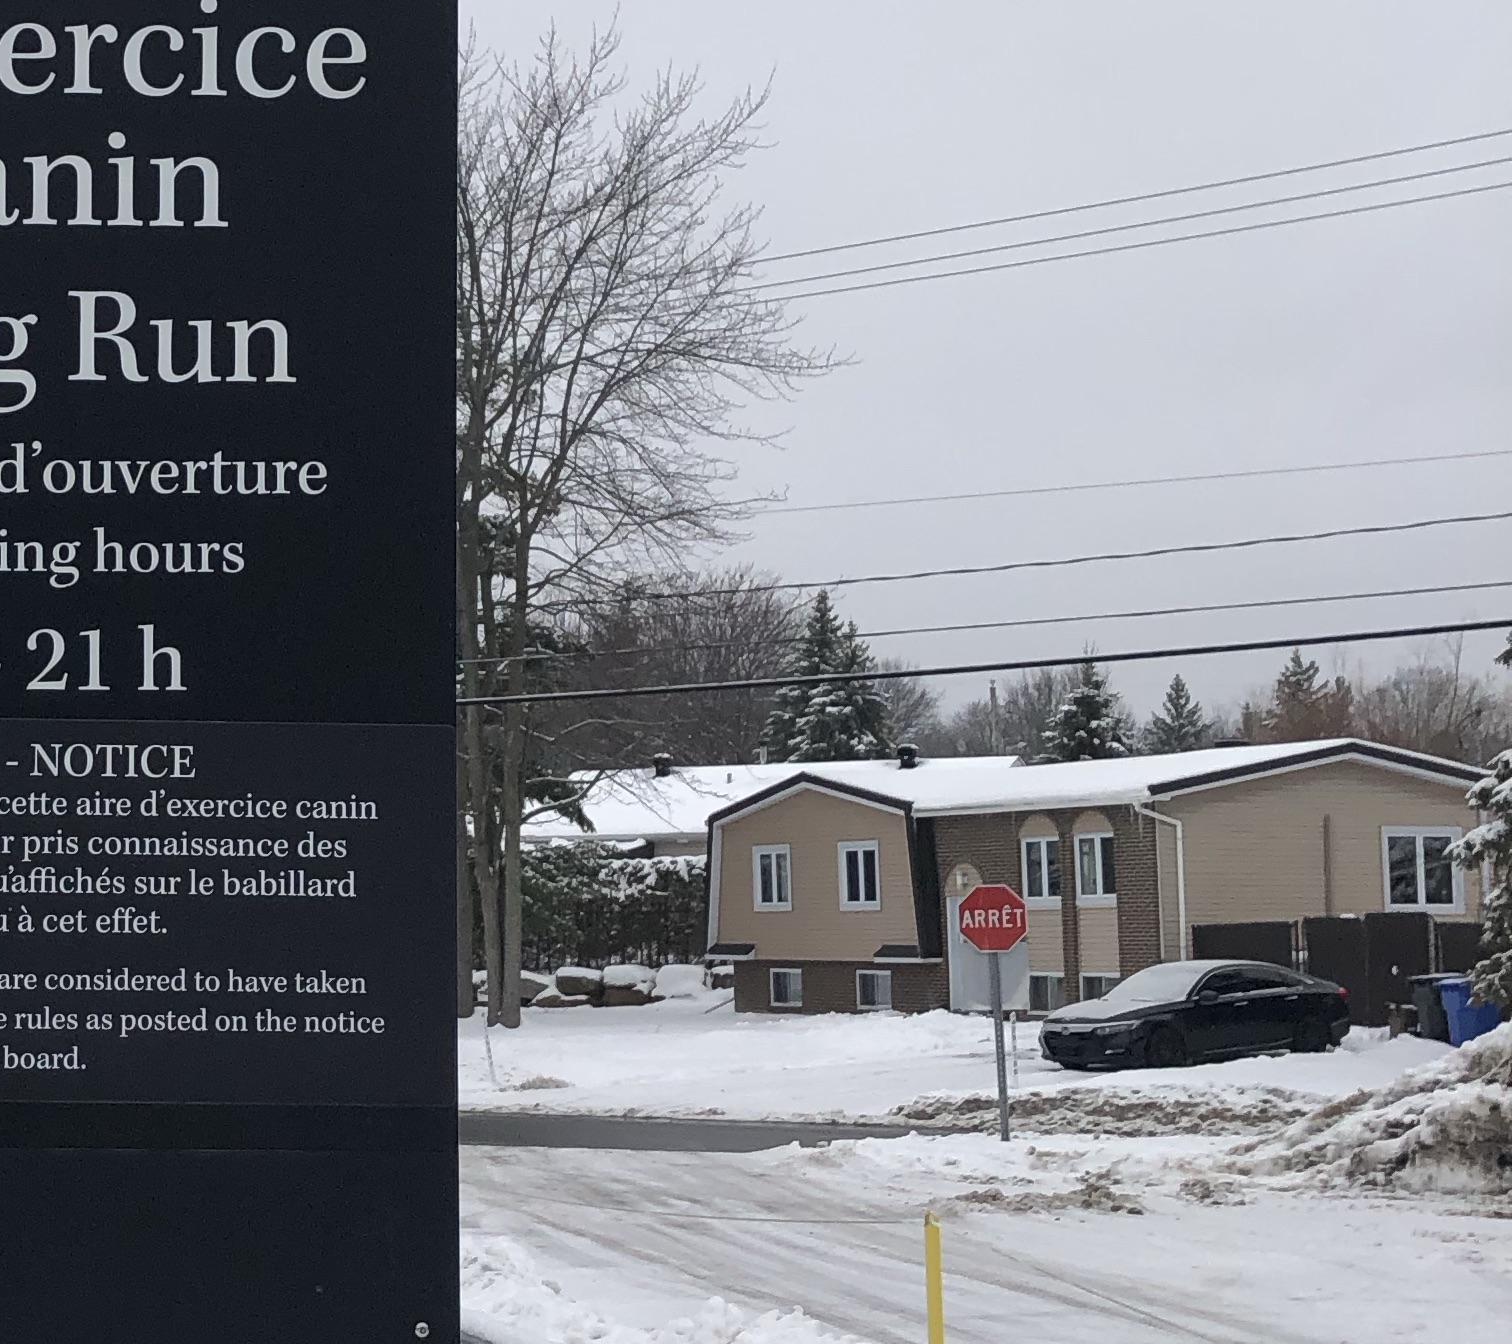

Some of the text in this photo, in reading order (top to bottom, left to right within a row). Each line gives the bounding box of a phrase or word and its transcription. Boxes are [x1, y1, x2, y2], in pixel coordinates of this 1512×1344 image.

[67, 291, 297, 384] Run
[92, 526, 245, 574] hours
[25, 628, 111, 691] 21
[137, 623, 188, 691] h
[29, 743, 196, 779] NOTICE
[76, 790, 132, 817] aire
[139, 788, 288, 819] d'exercice
[295, 794, 379, 820] canin
[21, 829, 79, 863] pris
[87, 830, 289, 858] connaissance
[297, 830, 347, 858] des
[134, 876, 182, 895] sur
[188, 868, 215, 896] le
[221, 868, 357, 898] babillard
[17, 904, 36, 933] à
[42, 909, 88, 934] cet
[95, 906, 168, 934] effet.
[961, 904, 1024, 929] ARRÊT
[44, 967, 188, 992] considered
[193, 971, 221, 992] to
[227, 968, 288, 993] have
[293, 969, 367, 994] taken
[13, 1005, 79, 1030] rules
[85, 1013, 113, 1031] as
[119, 1007, 209, 1038] posted
[214, 1015, 249, 1032] on
[254, 1008, 297, 1033] the
[303, 1010, 385, 1034] notice
[2, 1044, 87, 1070] board.
